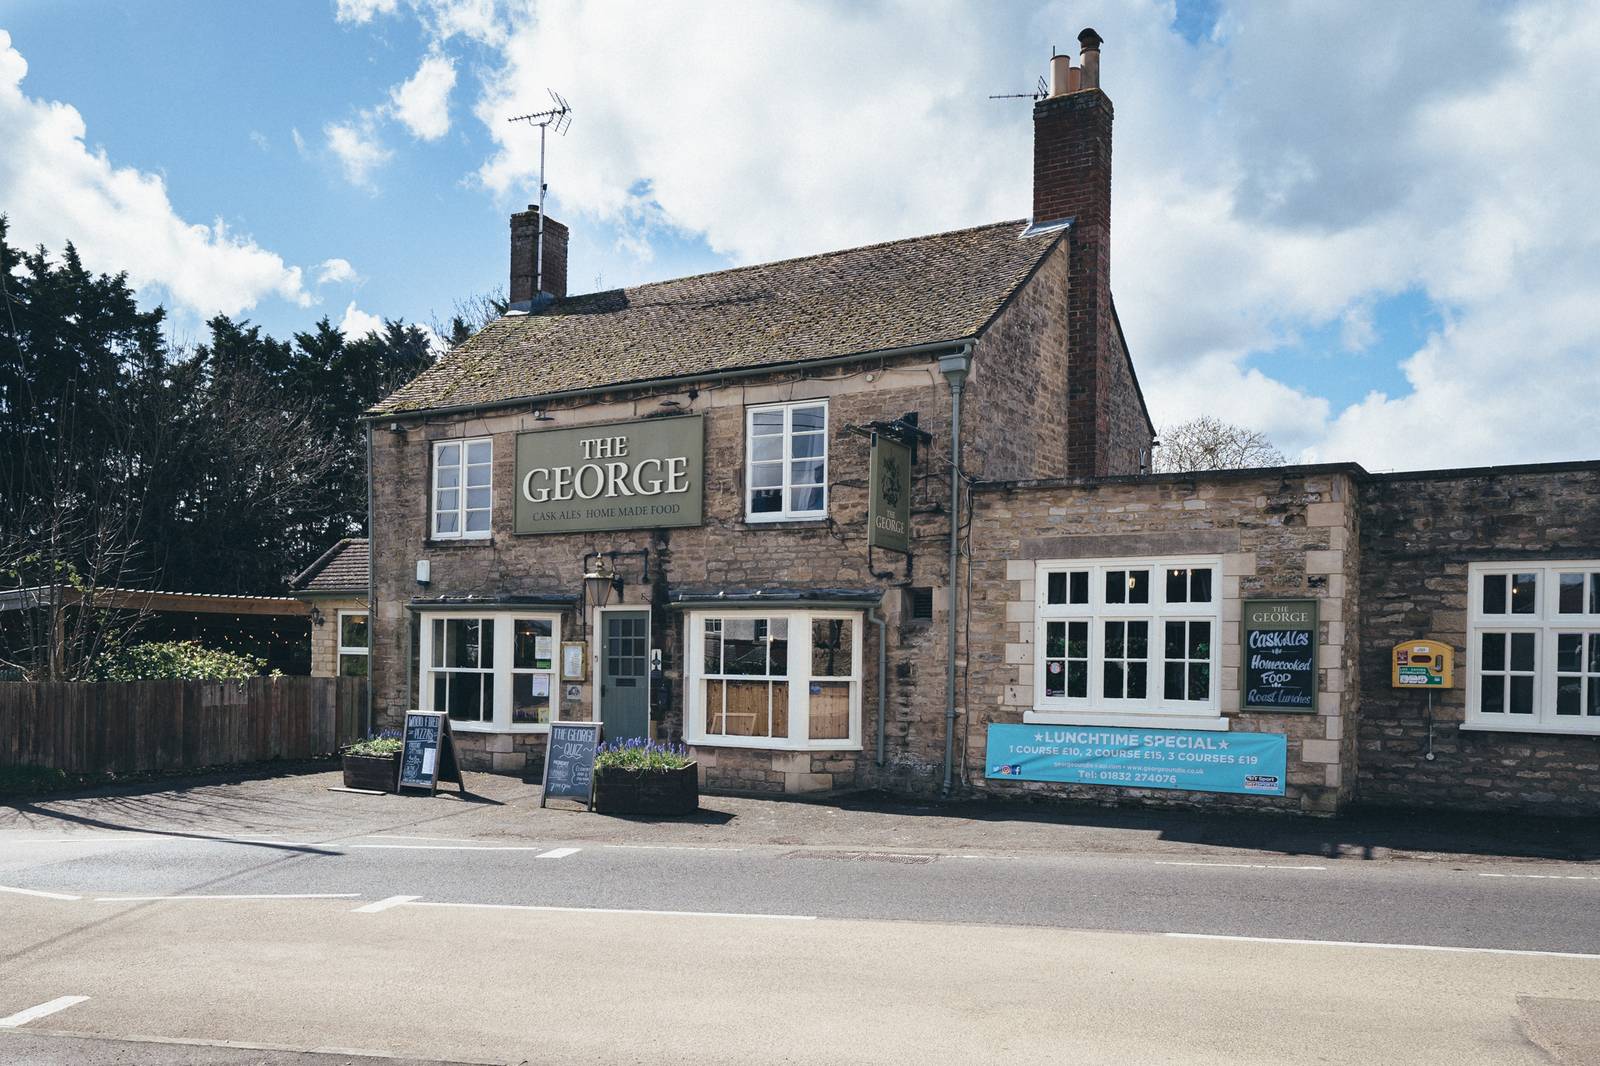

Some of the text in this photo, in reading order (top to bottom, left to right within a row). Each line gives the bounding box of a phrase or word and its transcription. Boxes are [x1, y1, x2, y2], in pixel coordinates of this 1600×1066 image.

[580, 436, 628, 460] THE
[522, 456, 690, 503] GEORGE
[532, 503, 681, 522] CASK ALES HOME MADE FOOD
[886, 509, 896, 519] THE
[875, 515, 905, 534] GEORGE
[1252, 612, 1309, 623] GEORGE
[1251, 654, 1312, 671] Homecooked
[1260, 671, 1292, 684] FOOD
[1248, 689, 1275, 703] Roast
[408, 716, 424, 727] WOOD
[414, 728, 434, 740] PIZZAS
[553, 728, 595, 742] THE GEORGE
[1045, 731, 1217, 750] LUNCHTIME SPECIAL
[563, 742, 583, 756] QUIZ
[1008, 745, 1259, 765] 1 COURSE £10, 2 COURSE £15, 3 COURSES £19
[1077, 770, 1177, 784] Tel: 01832 274076
